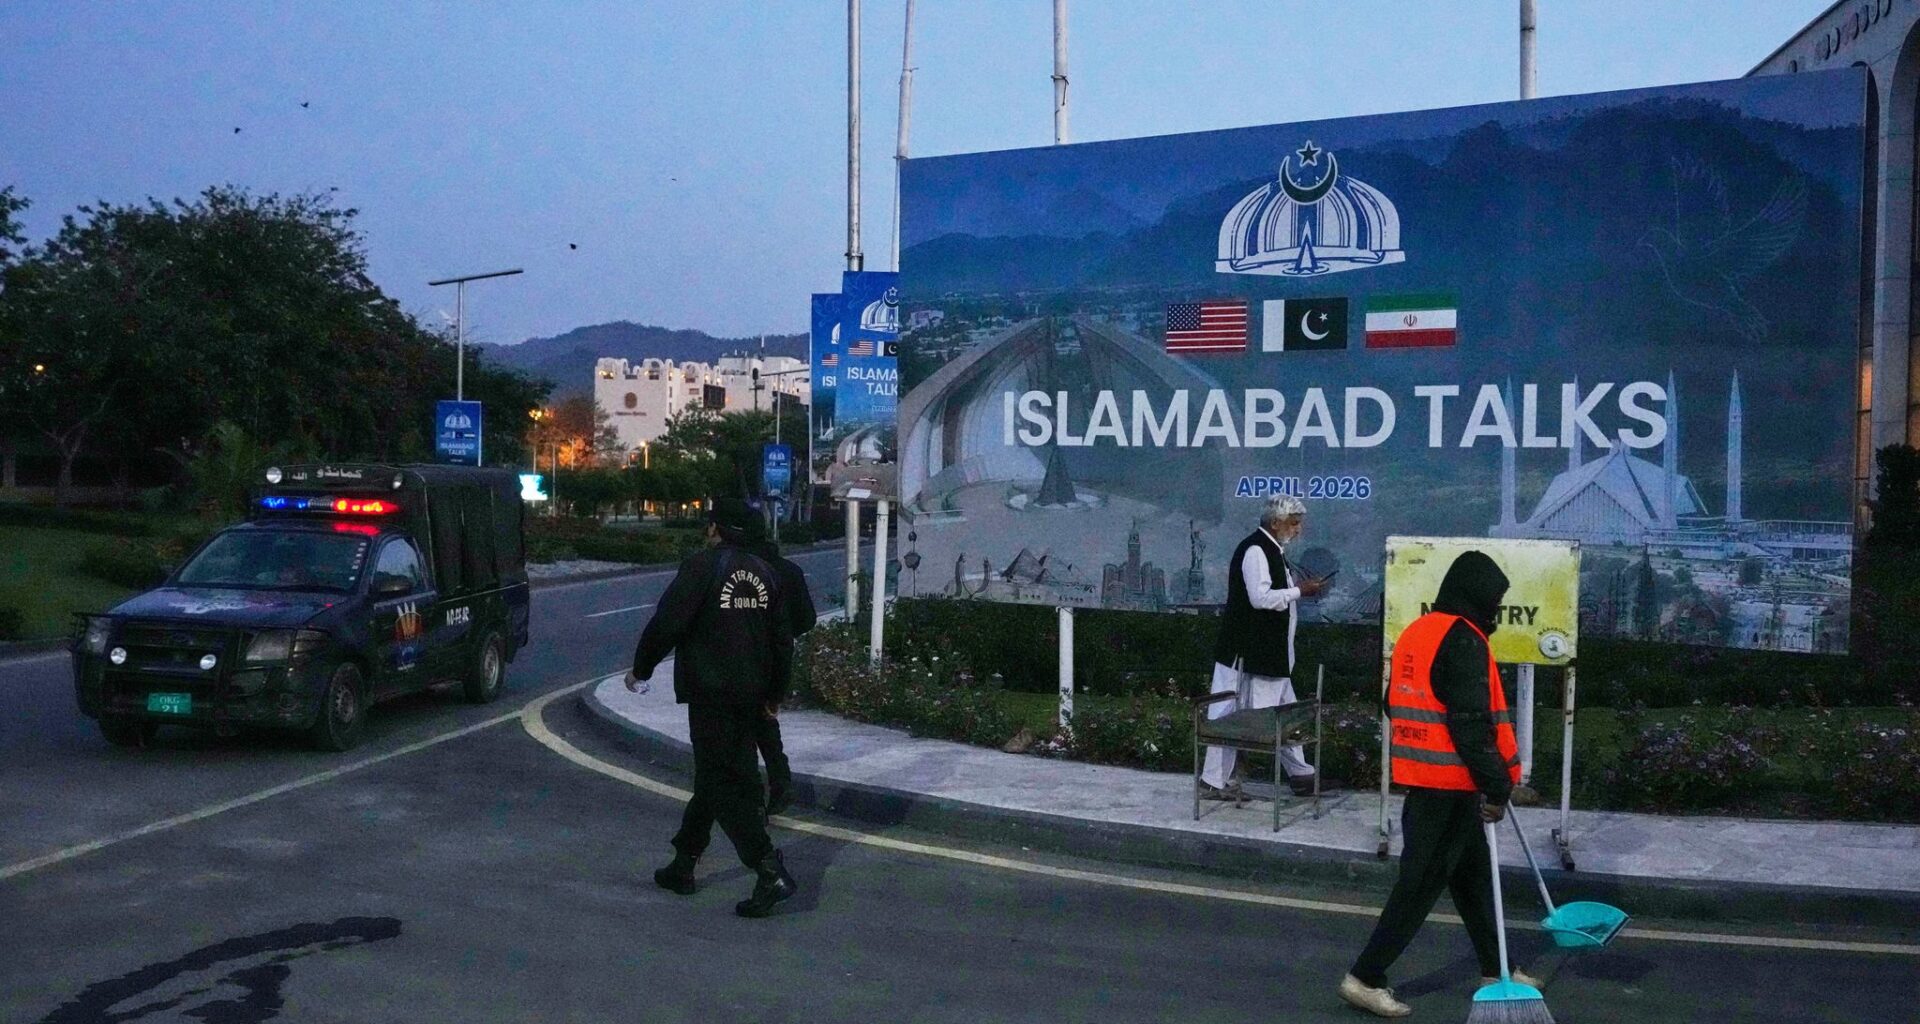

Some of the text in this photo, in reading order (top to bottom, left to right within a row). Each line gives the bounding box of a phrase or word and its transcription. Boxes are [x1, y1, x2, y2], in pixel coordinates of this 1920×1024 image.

[1003, 381, 1669, 449] ISLAMABAD TALKS
[1235, 476, 1371, 499] APRIL 2026
[720, 569, 769, 610] ANTI TERRORIST
[734, 597, 757, 609] SQUAD
[1498, 605, 1539, 625] TRY
